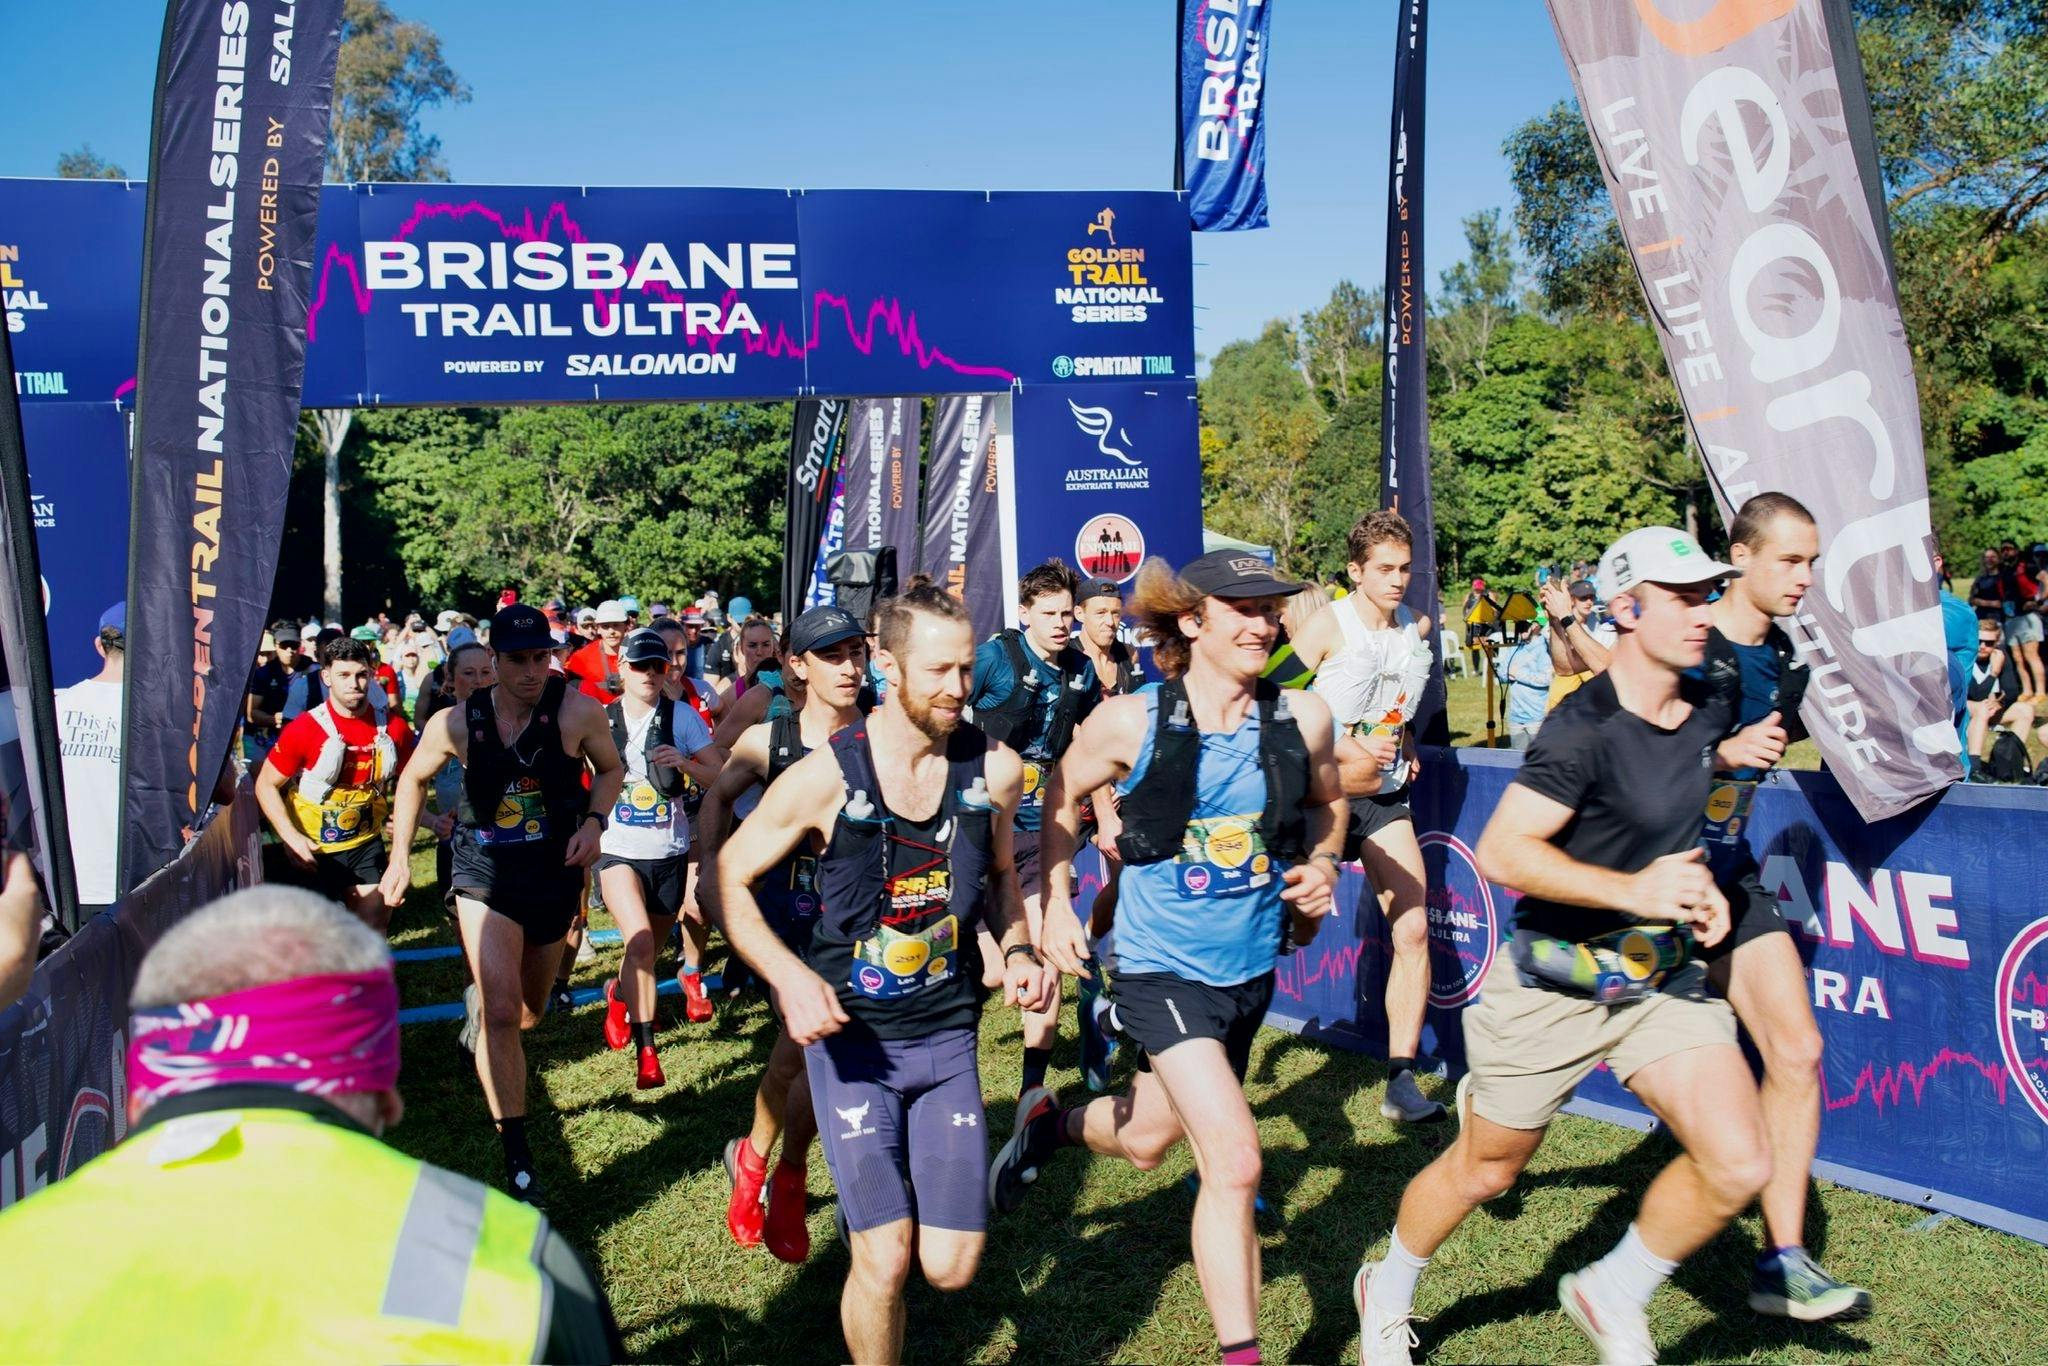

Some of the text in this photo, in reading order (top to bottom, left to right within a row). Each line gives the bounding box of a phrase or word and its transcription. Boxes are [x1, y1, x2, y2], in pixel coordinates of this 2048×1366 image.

[270, 0, 295, 86] SAL
[258, 115, 285, 291] POWERED BY
[1399, 194, 1409, 221] BY
[1601, 96, 1668, 221] LIVE
[1654, 270, 1724, 388] LIFE
[363, 240, 799, 291] BRISBANE
[1067, 247, 1145, 263] GOLDEN
[1067, 264, 1148, 285] TRAIL
[1055, 287, 1164, 304] NATIONAL
[1400, 229, 1412, 345] POWERED
[401, 302, 763, 337] TRAIL ULTRA
[1072, 305, 1148, 323] SERIES
[443, 360, 544, 373] POWERED BY
[566, 353, 737, 376] SALOMON
[1074, 356, 1175, 376] SPARTAN TRAIL
[24, 372, 69, 395] TRAIL
[891, 446, 902, 509] POWERED BY
[1065, 467, 1149, 481] AUSTRALIAN
[1065, 480, 1150, 491] EXPATRIATE FINANCE
[64, 710, 118, 735] This is
[67, 726, 109, 743] Trail
[60, 739, 121, 764] unning
[1437, 929, 1471, 944] ULTRA
